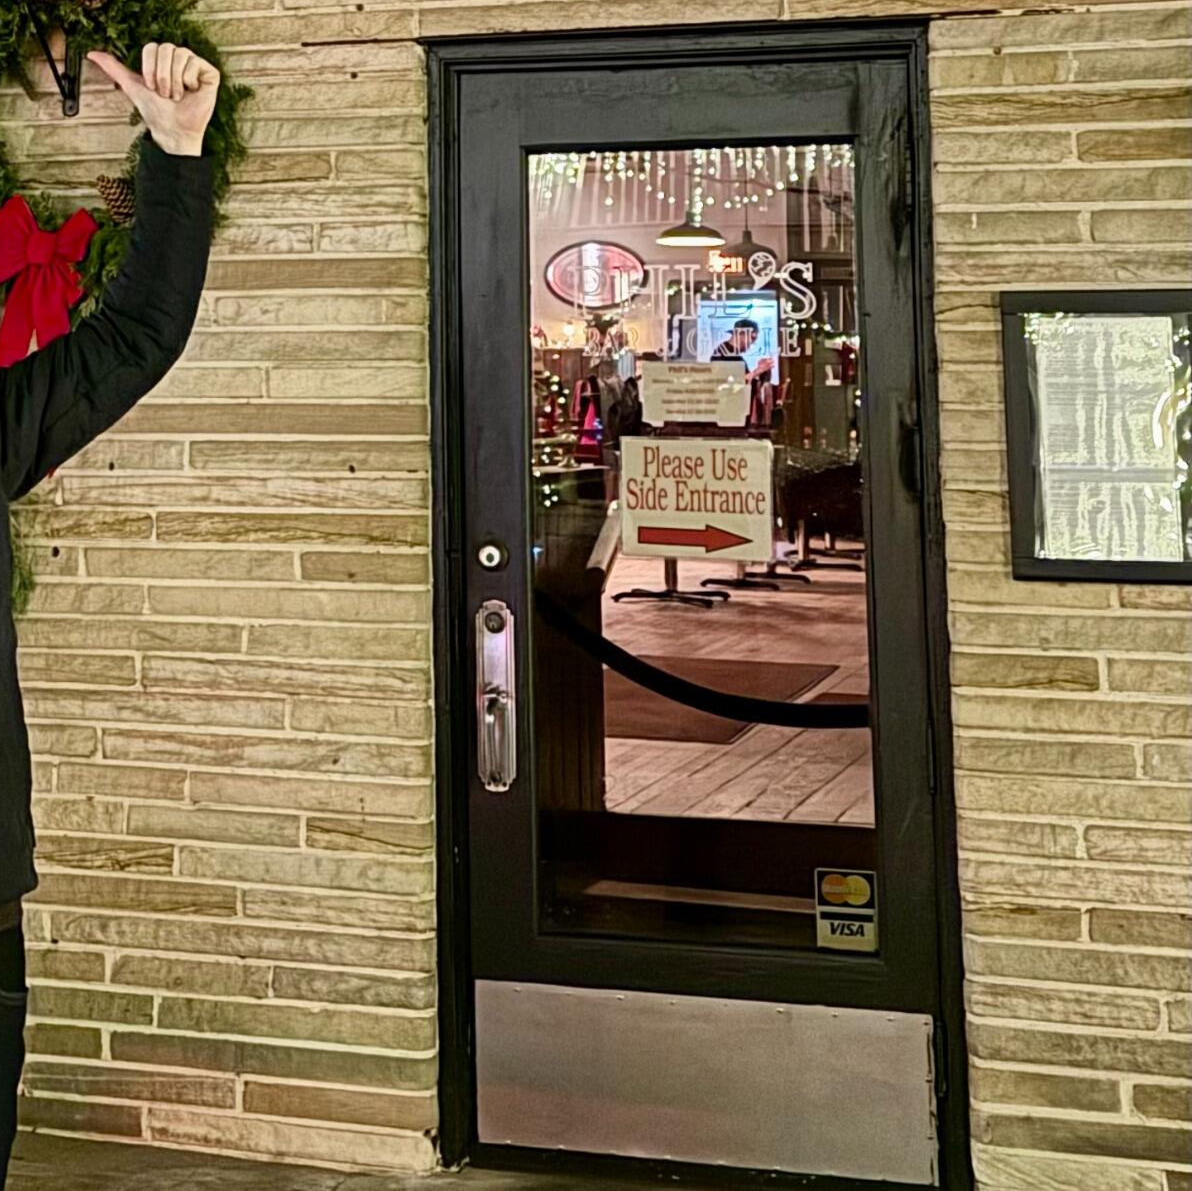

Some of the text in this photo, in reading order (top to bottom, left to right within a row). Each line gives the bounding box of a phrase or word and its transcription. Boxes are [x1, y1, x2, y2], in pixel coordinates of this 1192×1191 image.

[643, 446, 748, 481] Please Use
[626, 478, 766, 515] Side Entrance
[829, 921, 865, 938] VISA
